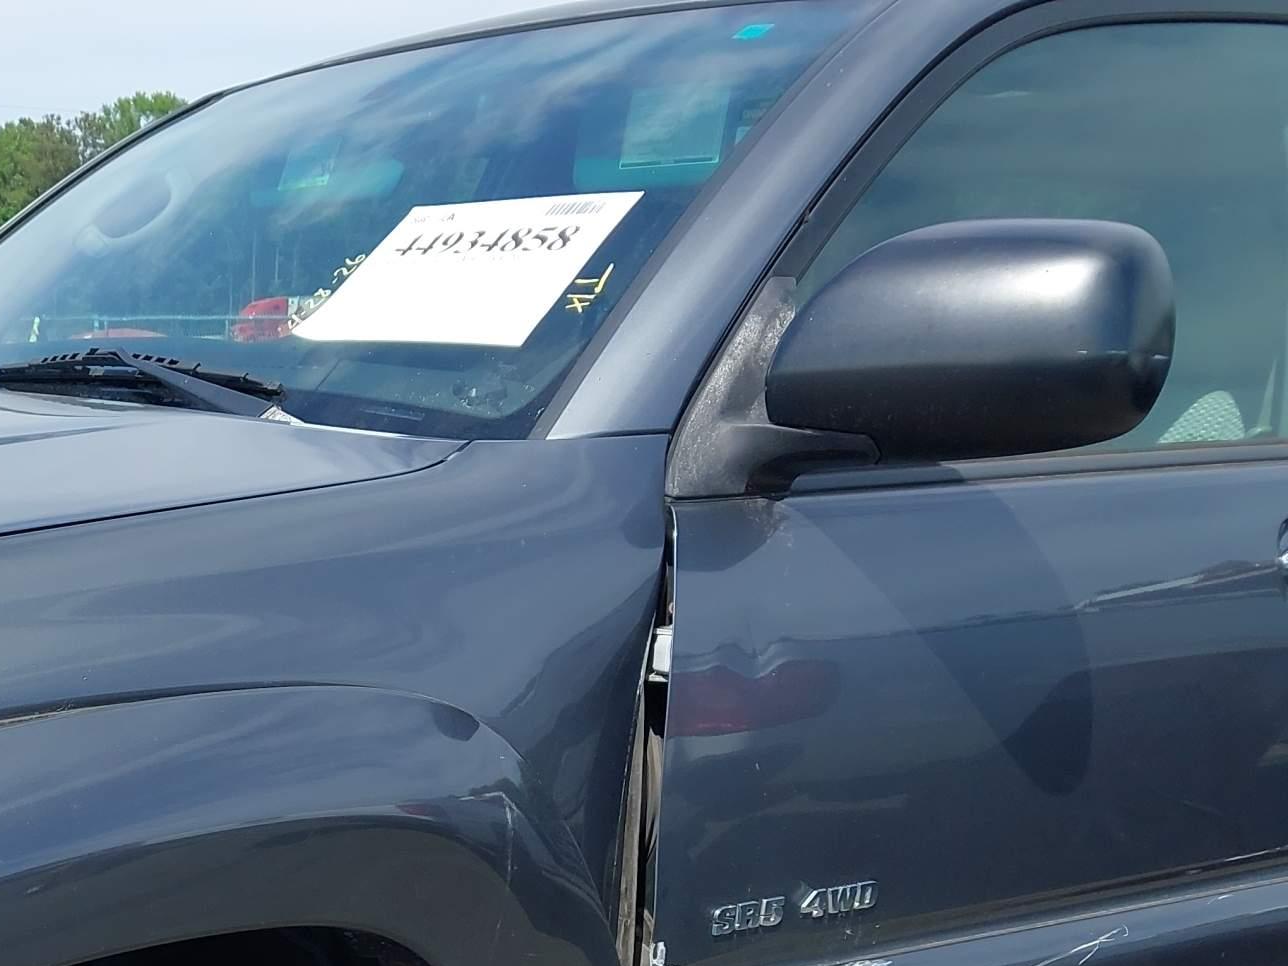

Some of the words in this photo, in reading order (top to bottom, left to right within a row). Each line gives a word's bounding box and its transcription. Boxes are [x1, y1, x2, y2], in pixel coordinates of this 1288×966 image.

[396, 225, 580, 256] 44934858
[712, 896, 785, 936] SR5
[800, 880, 878, 917] 4WD
